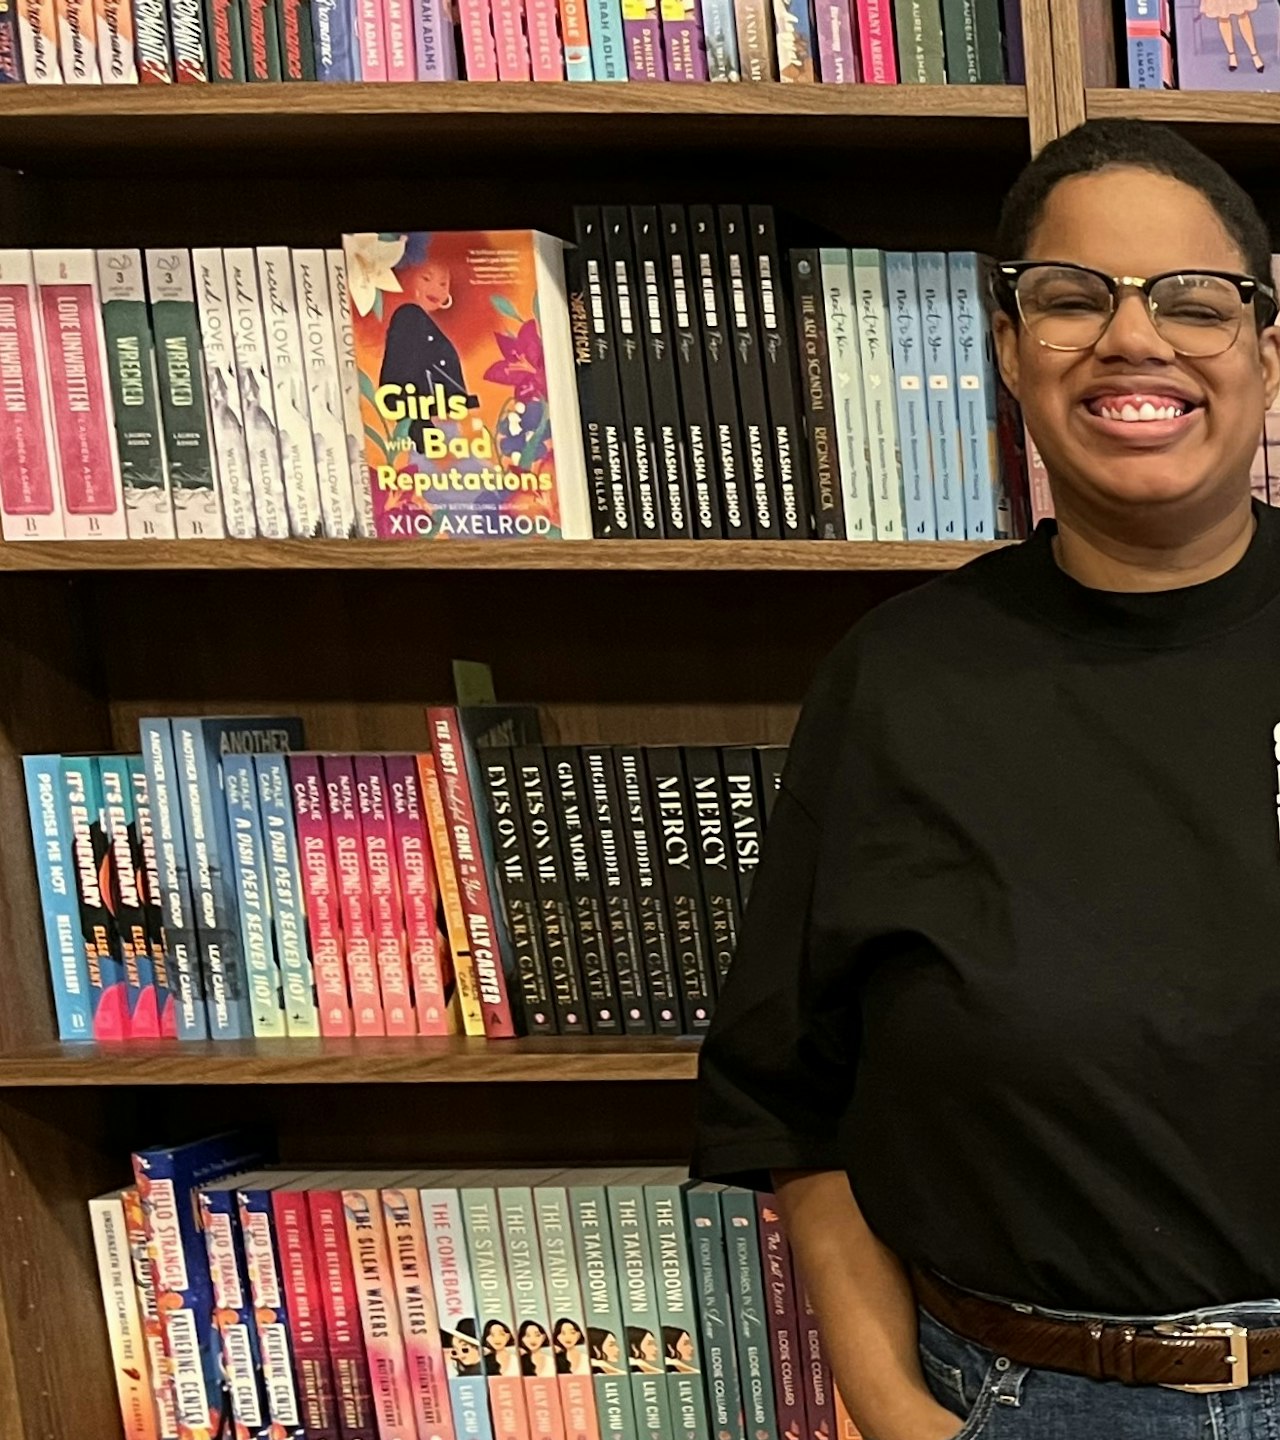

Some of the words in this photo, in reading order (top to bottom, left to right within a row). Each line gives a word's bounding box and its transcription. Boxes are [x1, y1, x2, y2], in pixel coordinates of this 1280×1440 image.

[168, 336, 194, 409] WRECKED
[374, 382, 469, 422] Girls
[385, 436, 418, 452] with
[422, 428, 491, 461] Bad
[605, 426, 624, 478] NATASHA
[378, 464, 552, 494] Reputations
[390, 512, 433, 535] XIO
[439, 512, 551, 535] AXELROD
[608, 481, 625, 529] BISHOP
[220, 730, 290, 752] ANOTHER
[659, 776, 690, 869] MERCY
[580, 1201, 598, 1233] THE
[586, 1233, 610, 1315] TAKEDOWN
